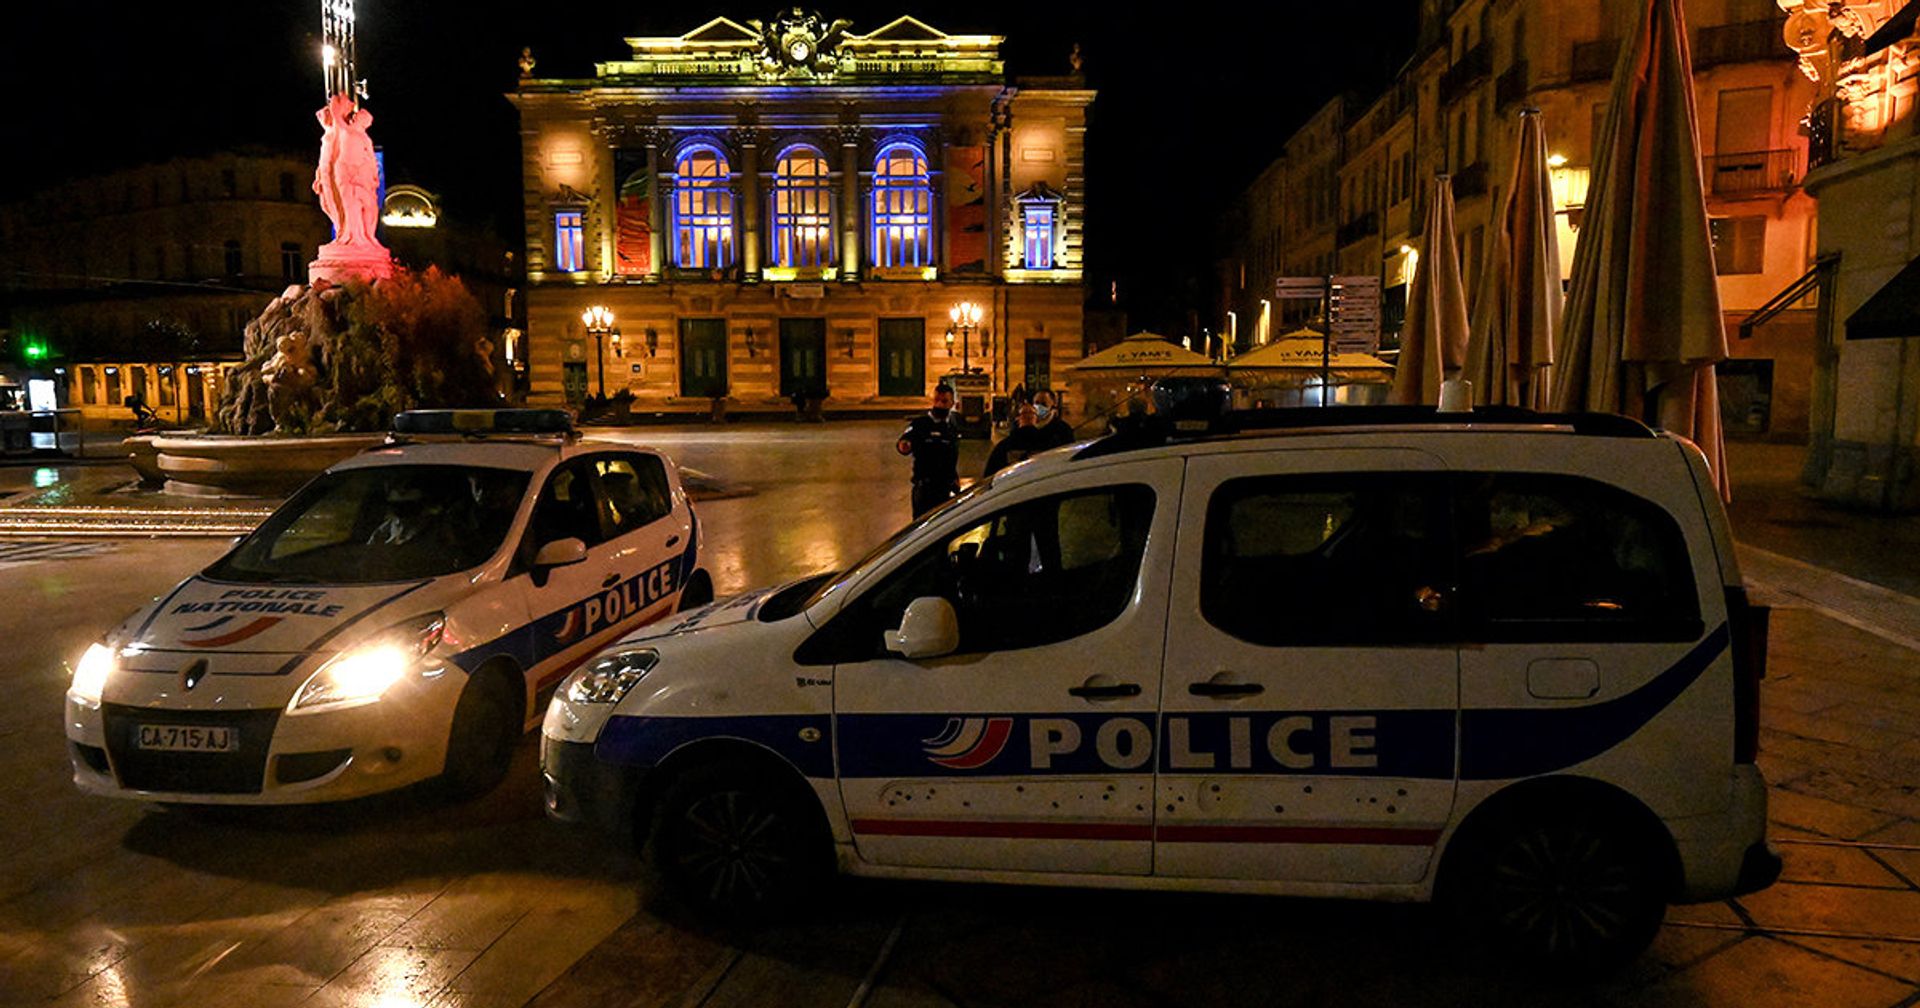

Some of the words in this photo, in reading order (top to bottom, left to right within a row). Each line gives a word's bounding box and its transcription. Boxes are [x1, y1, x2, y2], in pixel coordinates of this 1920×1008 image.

[171, 600, 345, 618] NATIONALE
[219, 588, 328, 601] POLICE
[585, 563, 673, 636] POLICE
[1029, 716, 1379, 770] POLICE
